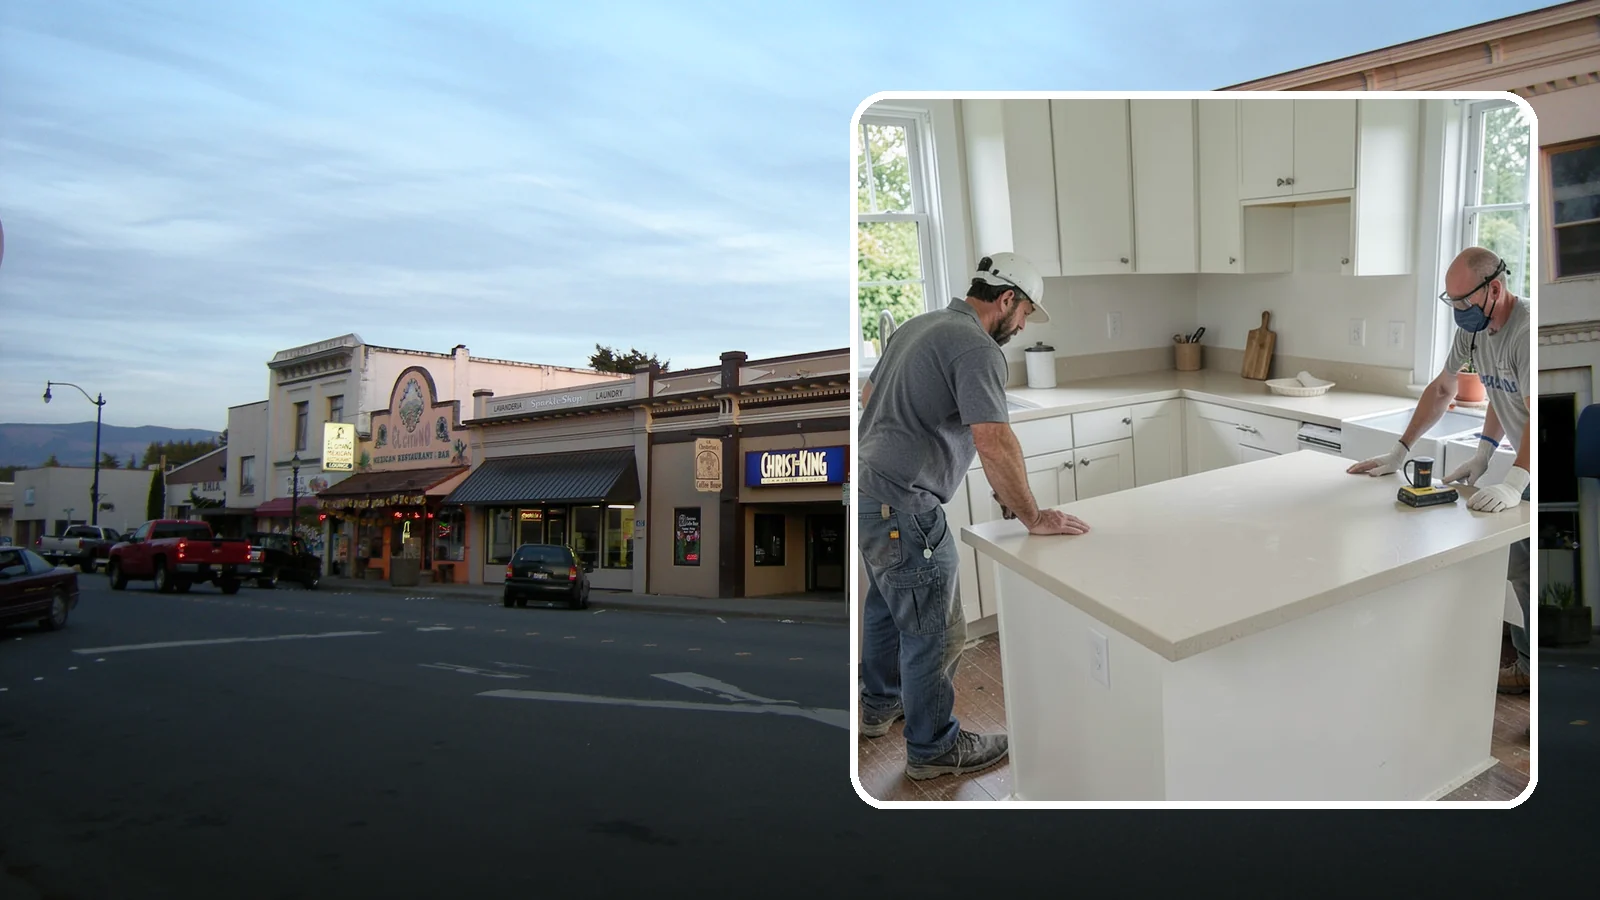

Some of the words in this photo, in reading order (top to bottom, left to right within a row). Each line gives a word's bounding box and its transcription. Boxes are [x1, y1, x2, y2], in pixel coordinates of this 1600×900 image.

[493, 402, 522, 413] LAVANDERIA
[530, 396, 560, 409] Sparkle
[561, 394, 582, 404] Shop
[595, 389, 624, 400] LAUNDRY
[374, 455, 396, 464] MEXICAN
[397, 451, 433, 462] RESTAURANT
[437, 450, 450, 459] BAR
[799, 450, 828, 476] KING
[696, 481, 709, 489] Coffee
[710, 481, 722, 489] House
